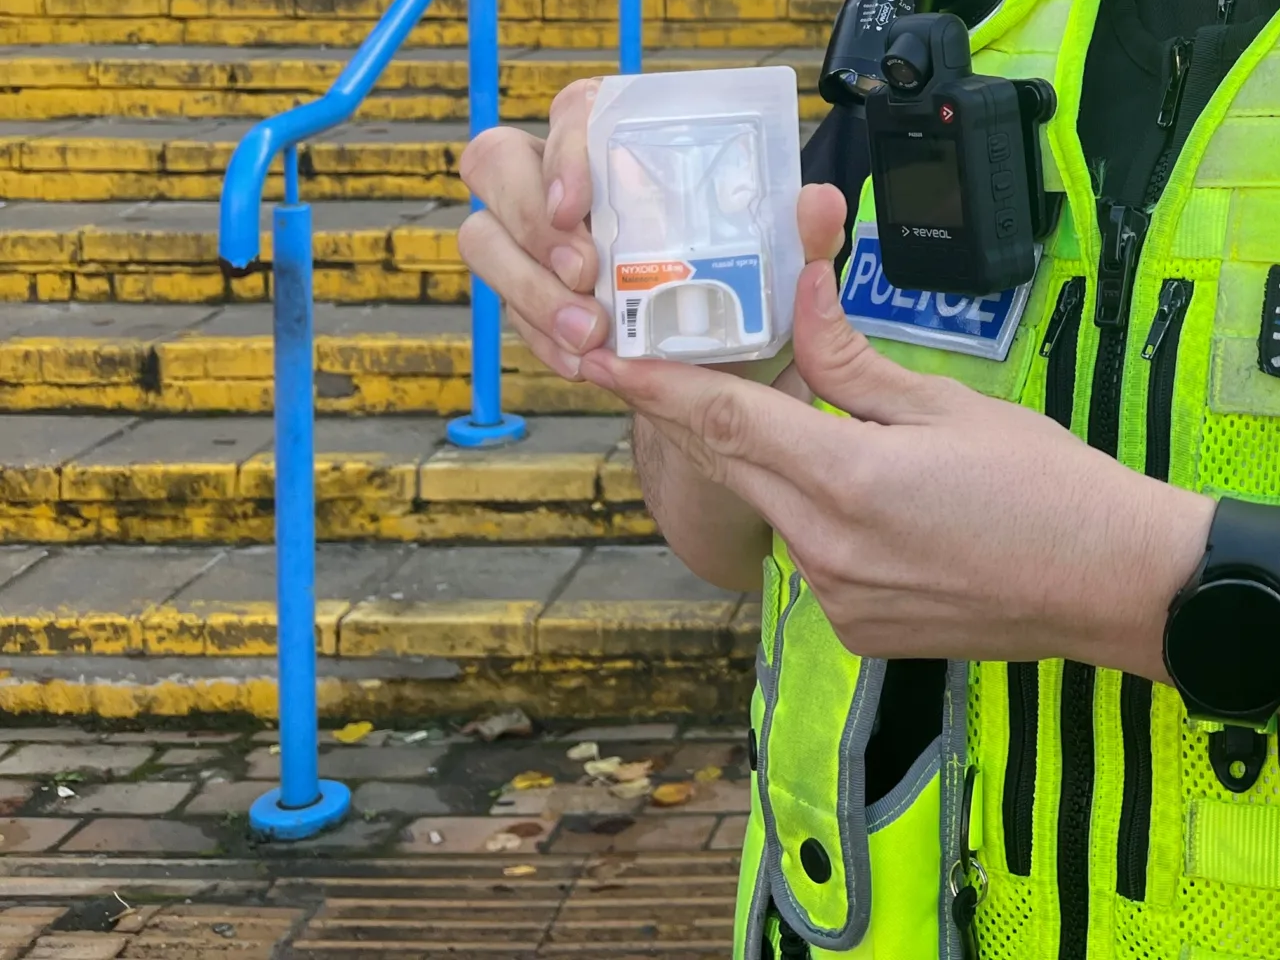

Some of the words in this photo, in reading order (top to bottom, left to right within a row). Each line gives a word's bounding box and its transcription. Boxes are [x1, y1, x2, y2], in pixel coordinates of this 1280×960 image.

[879, 5, 890, 22] ZOOM
[711, 259, 734, 268] nasal
[735, 258, 758, 268] spray
[621, 264, 659, 274] NYXOID
